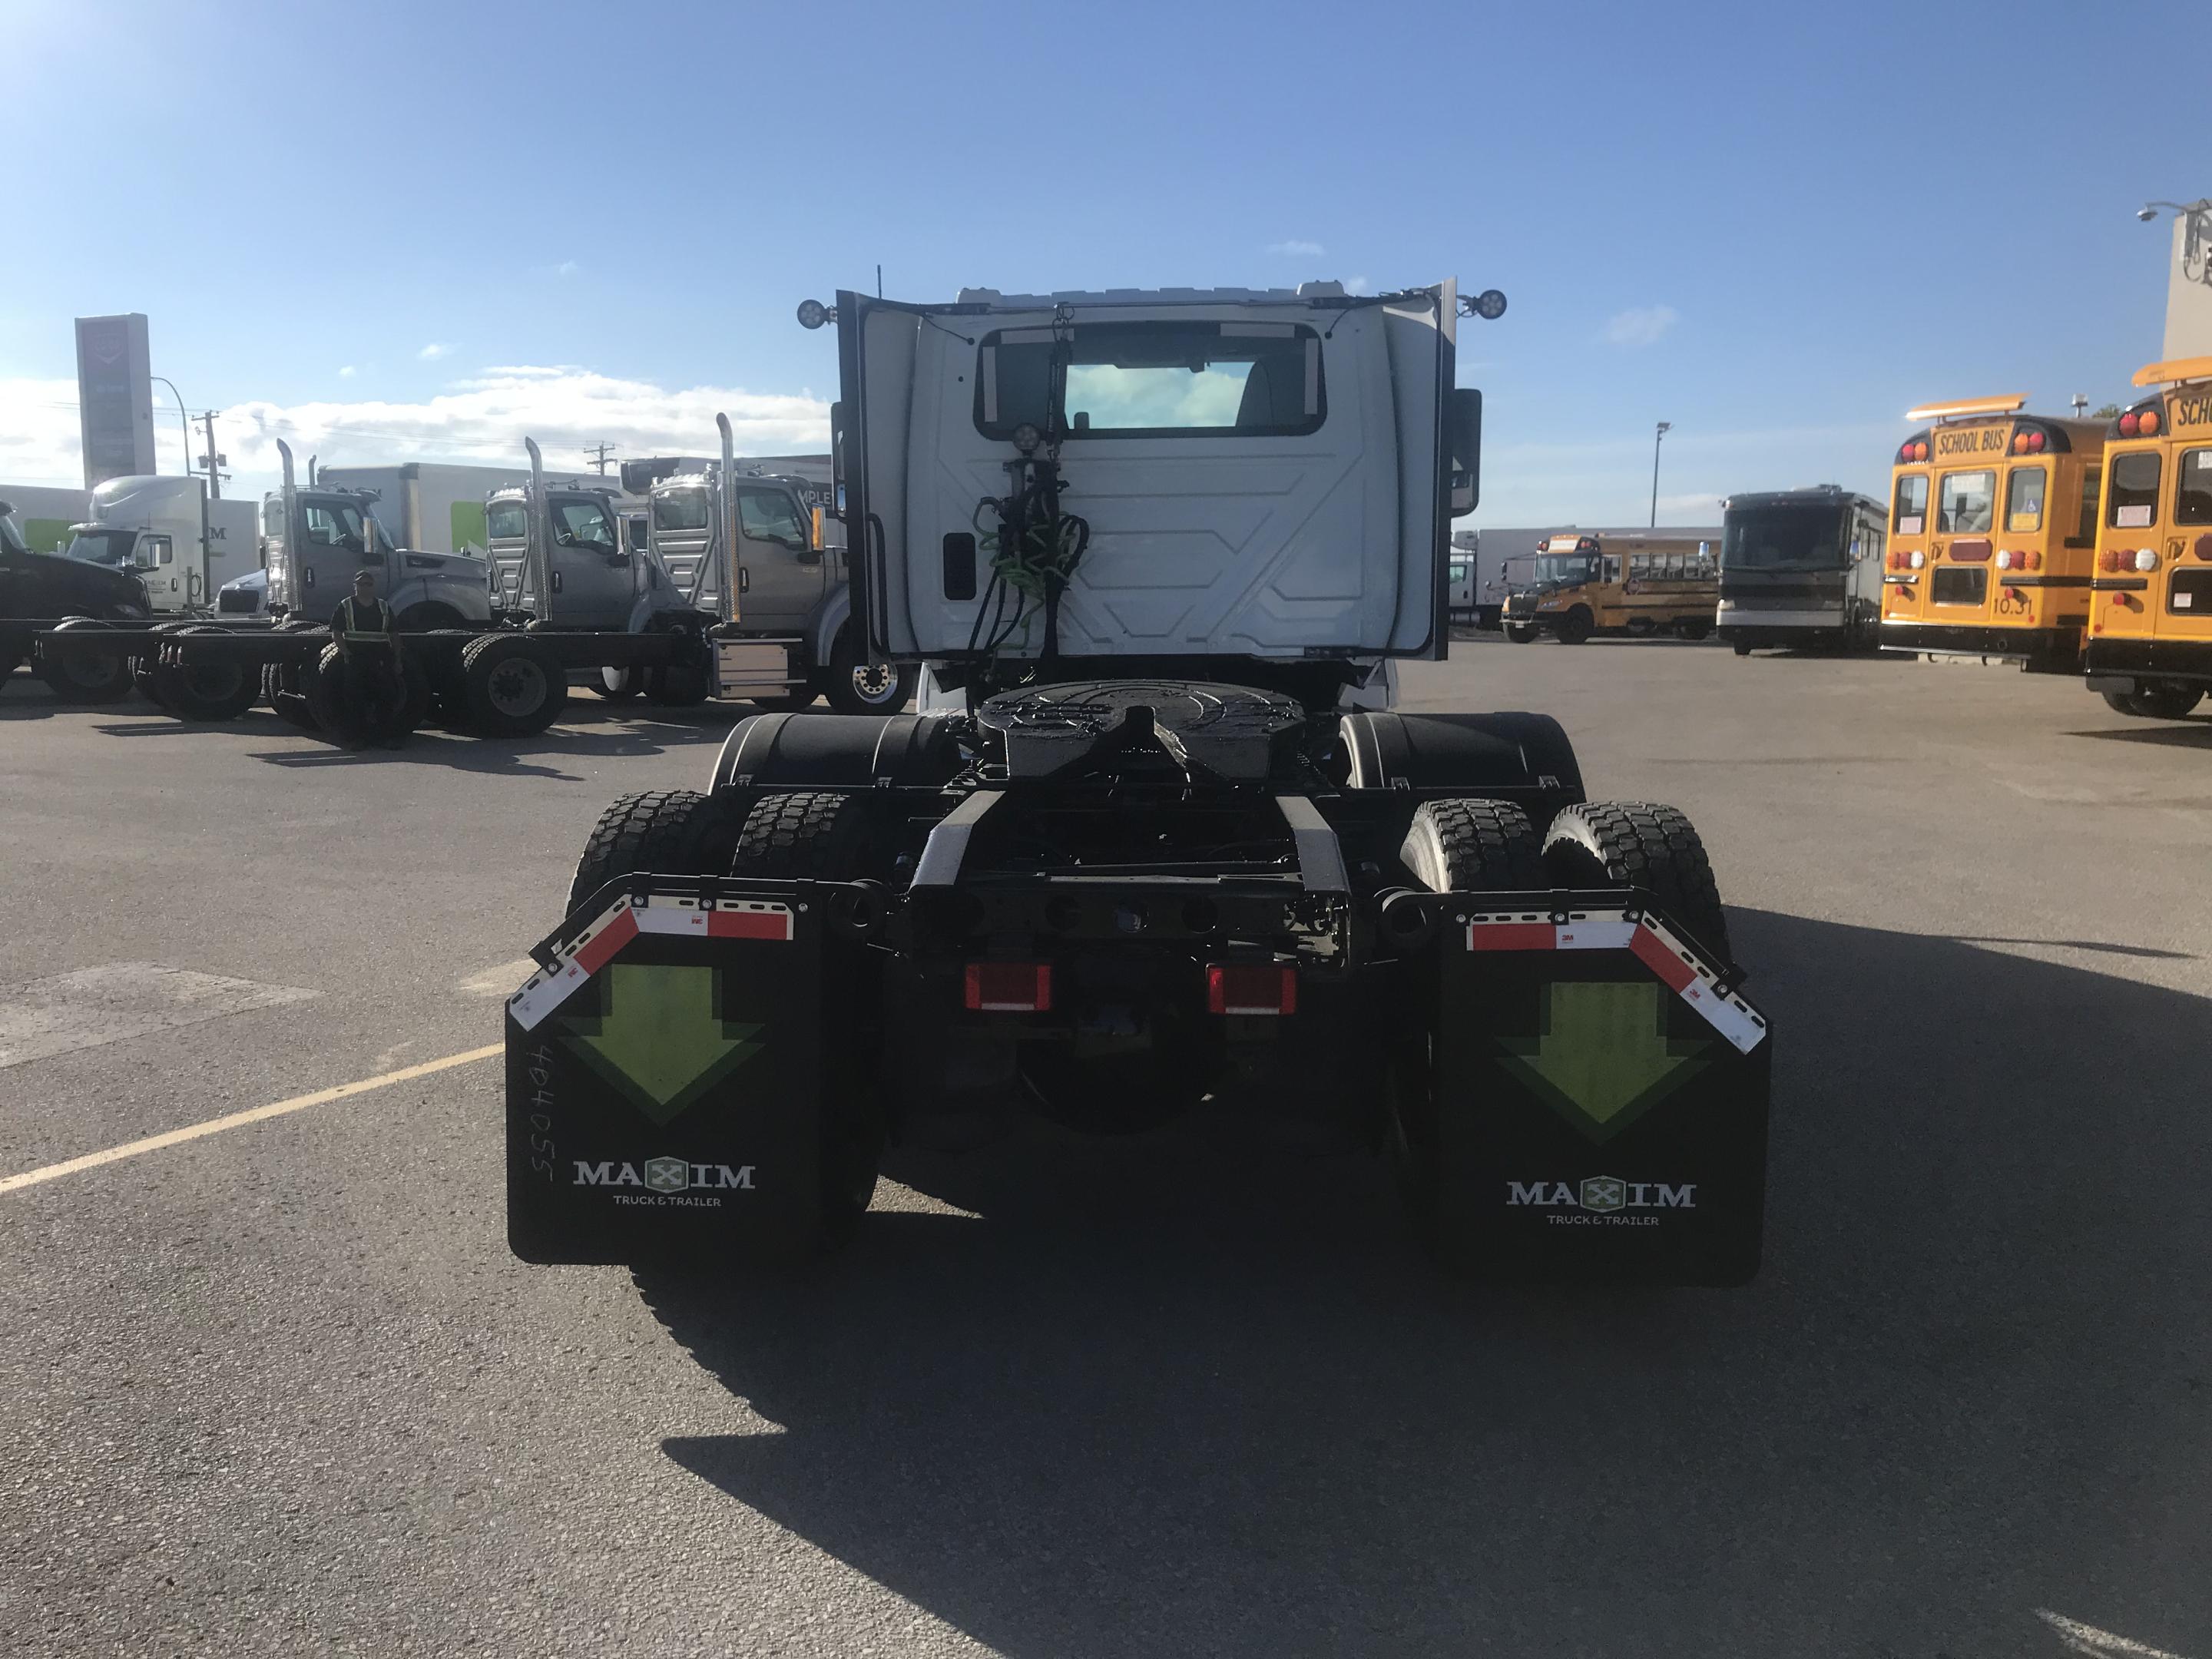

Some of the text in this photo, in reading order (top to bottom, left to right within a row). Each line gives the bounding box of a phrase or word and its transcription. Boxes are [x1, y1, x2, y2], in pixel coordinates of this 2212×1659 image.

[2177, 397, 2212, 426] SCH
[1939, 428, 2005, 455] SCHOOL BUS
[1689, 988, 1700, 999] 3M
[573, 1161, 756, 1189] MAXIM
[613, 1195, 721, 1207] TRUCK & TRAILER
[1505, 1181, 1697, 1207] MAXIM
[1546, 1214, 1659, 1226] TRUCK & TRAILER
